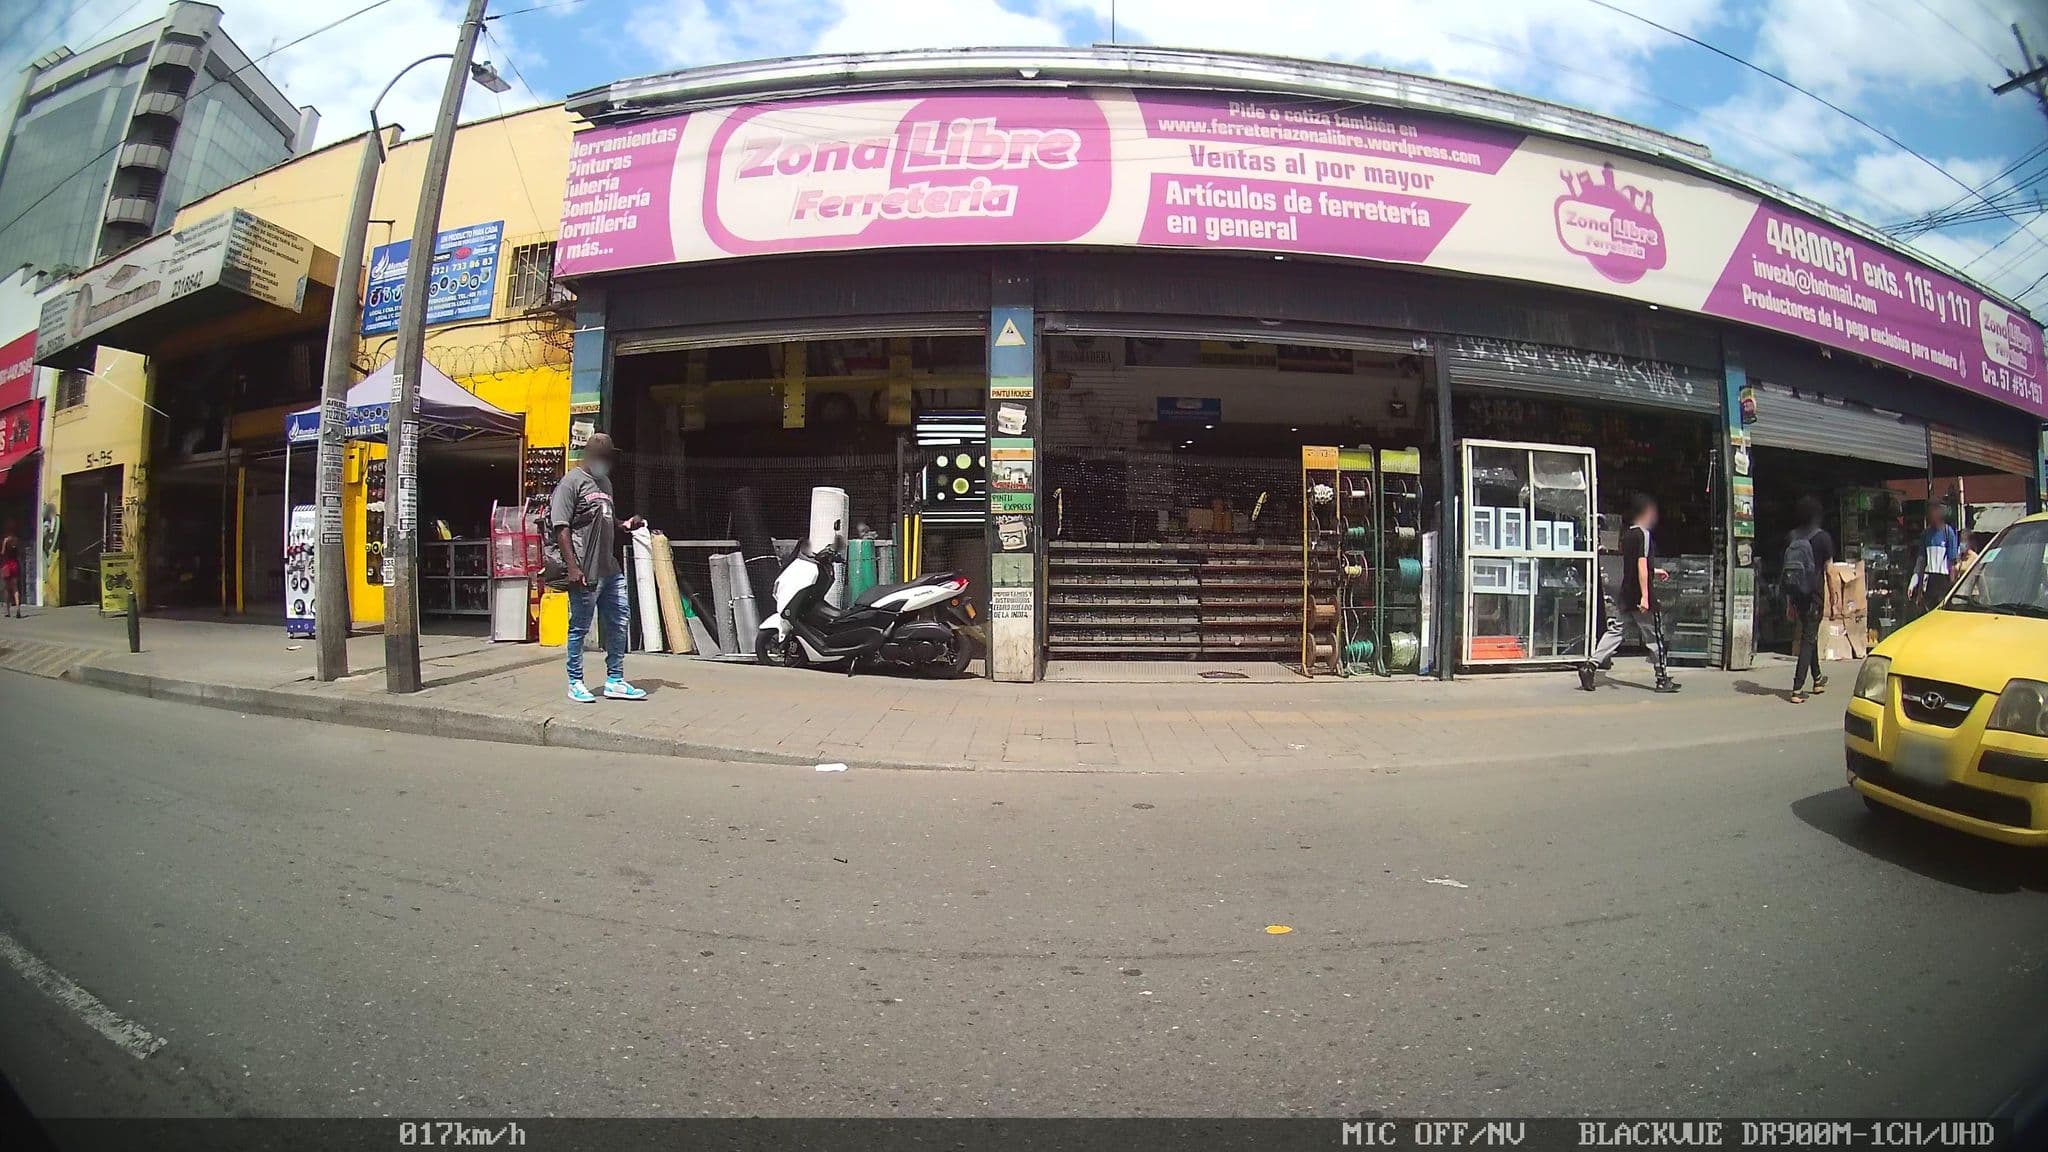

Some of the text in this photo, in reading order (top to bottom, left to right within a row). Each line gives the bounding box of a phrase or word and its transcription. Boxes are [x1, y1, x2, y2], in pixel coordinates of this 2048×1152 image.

[1228, 101, 1418, 137] Pide o cotiza también en
[569, 128, 677, 159] Herramientas
[737, 117, 1081, 180] Zona Libre
[1158, 118, 1482, 166] www.ferreteriazonalibre.wordpress.com
[568, 155, 632, 178] Pinturas
[1189, 144, 1435, 192] Ventas al por mayor
[561, 187, 651, 219] Bombillería
[793, 177, 1017, 220] Ferreteria
[1165, 180, 1431, 228] Artículos de ferretería
[560, 211, 637, 240] Tornillería
[1167, 214, 1298, 241] en general
[1566, 210, 1659, 246] Zona Libre
[567, 237, 614, 260] más...
[1766, 217, 1971, 328] 4480031 exts. 115 y 117
[1741, 283, 1958, 371] Productores de la pega exclusiva para madera
[1983, 312, 2008, 339] Zona
[1981, 361, 2000, 388] Cra.
[2000, 367, 2010, 391] 57
[1011, 390, 1032, 398] HOUSE
[1003, 503, 1032, 511] EXPRESS
